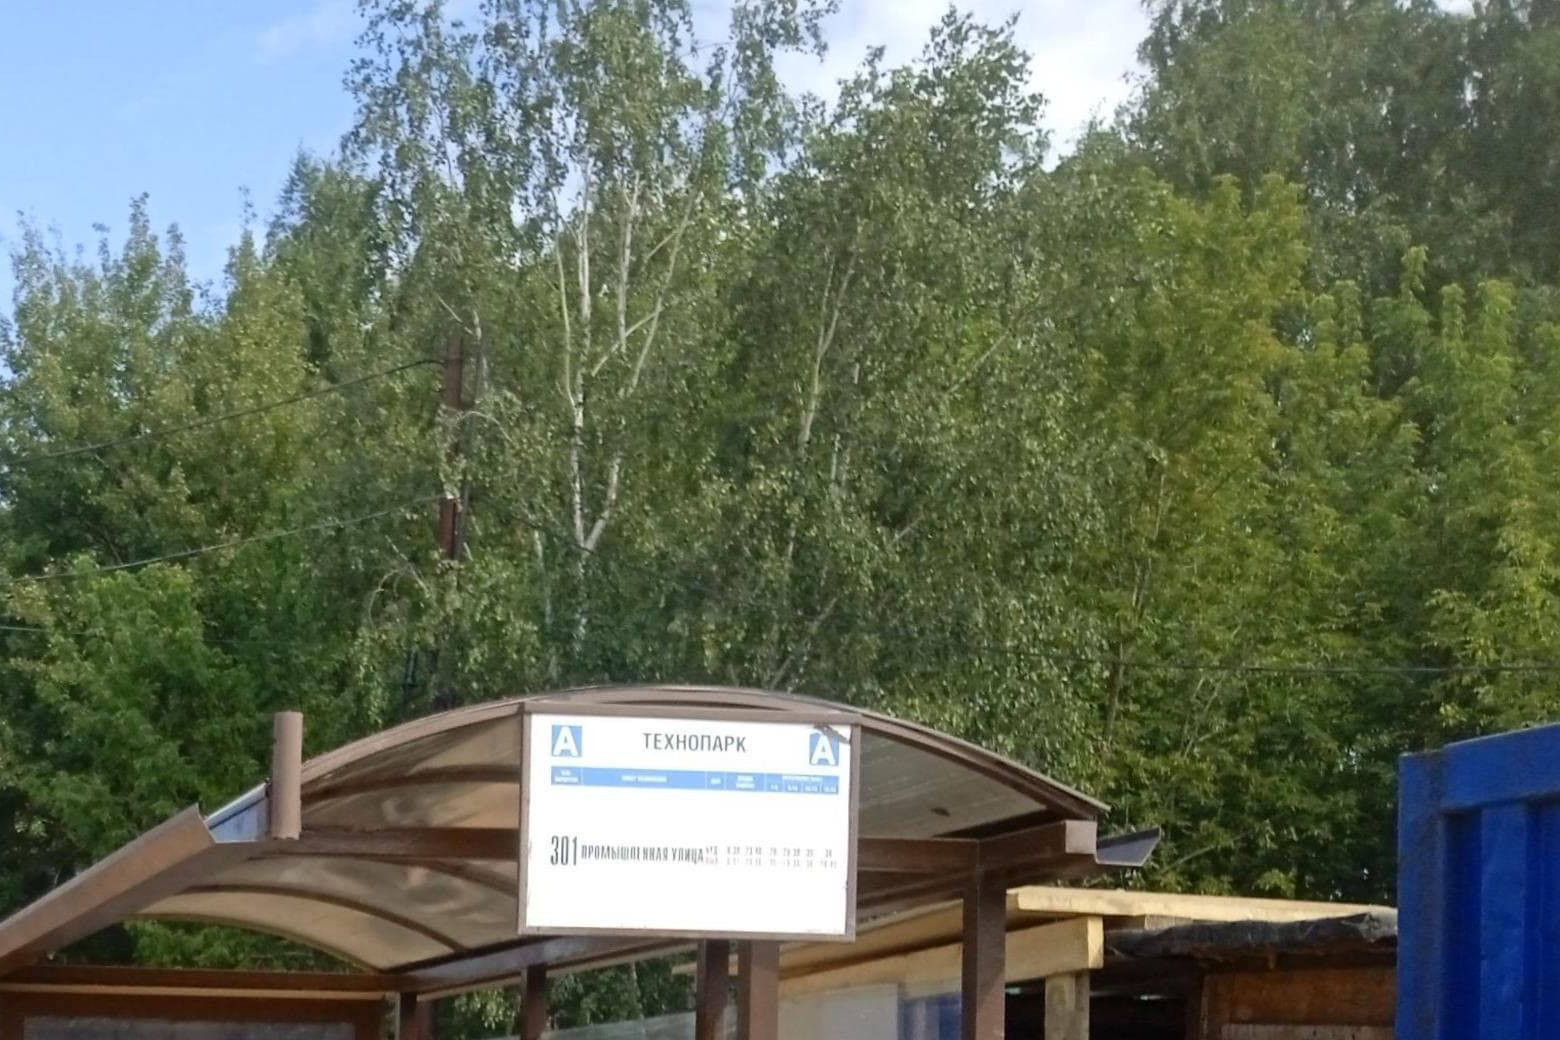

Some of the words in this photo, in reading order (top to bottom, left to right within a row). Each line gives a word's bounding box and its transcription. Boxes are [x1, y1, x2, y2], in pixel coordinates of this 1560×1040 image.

[643, 732, 747, 753] ТЕХНОПАРК
[550, 835, 578, 866] 301
[581, 844, 668, 862] ПРОМЫШЛЕННАЯ
[672, 847, 704, 864] УЛИЦА
